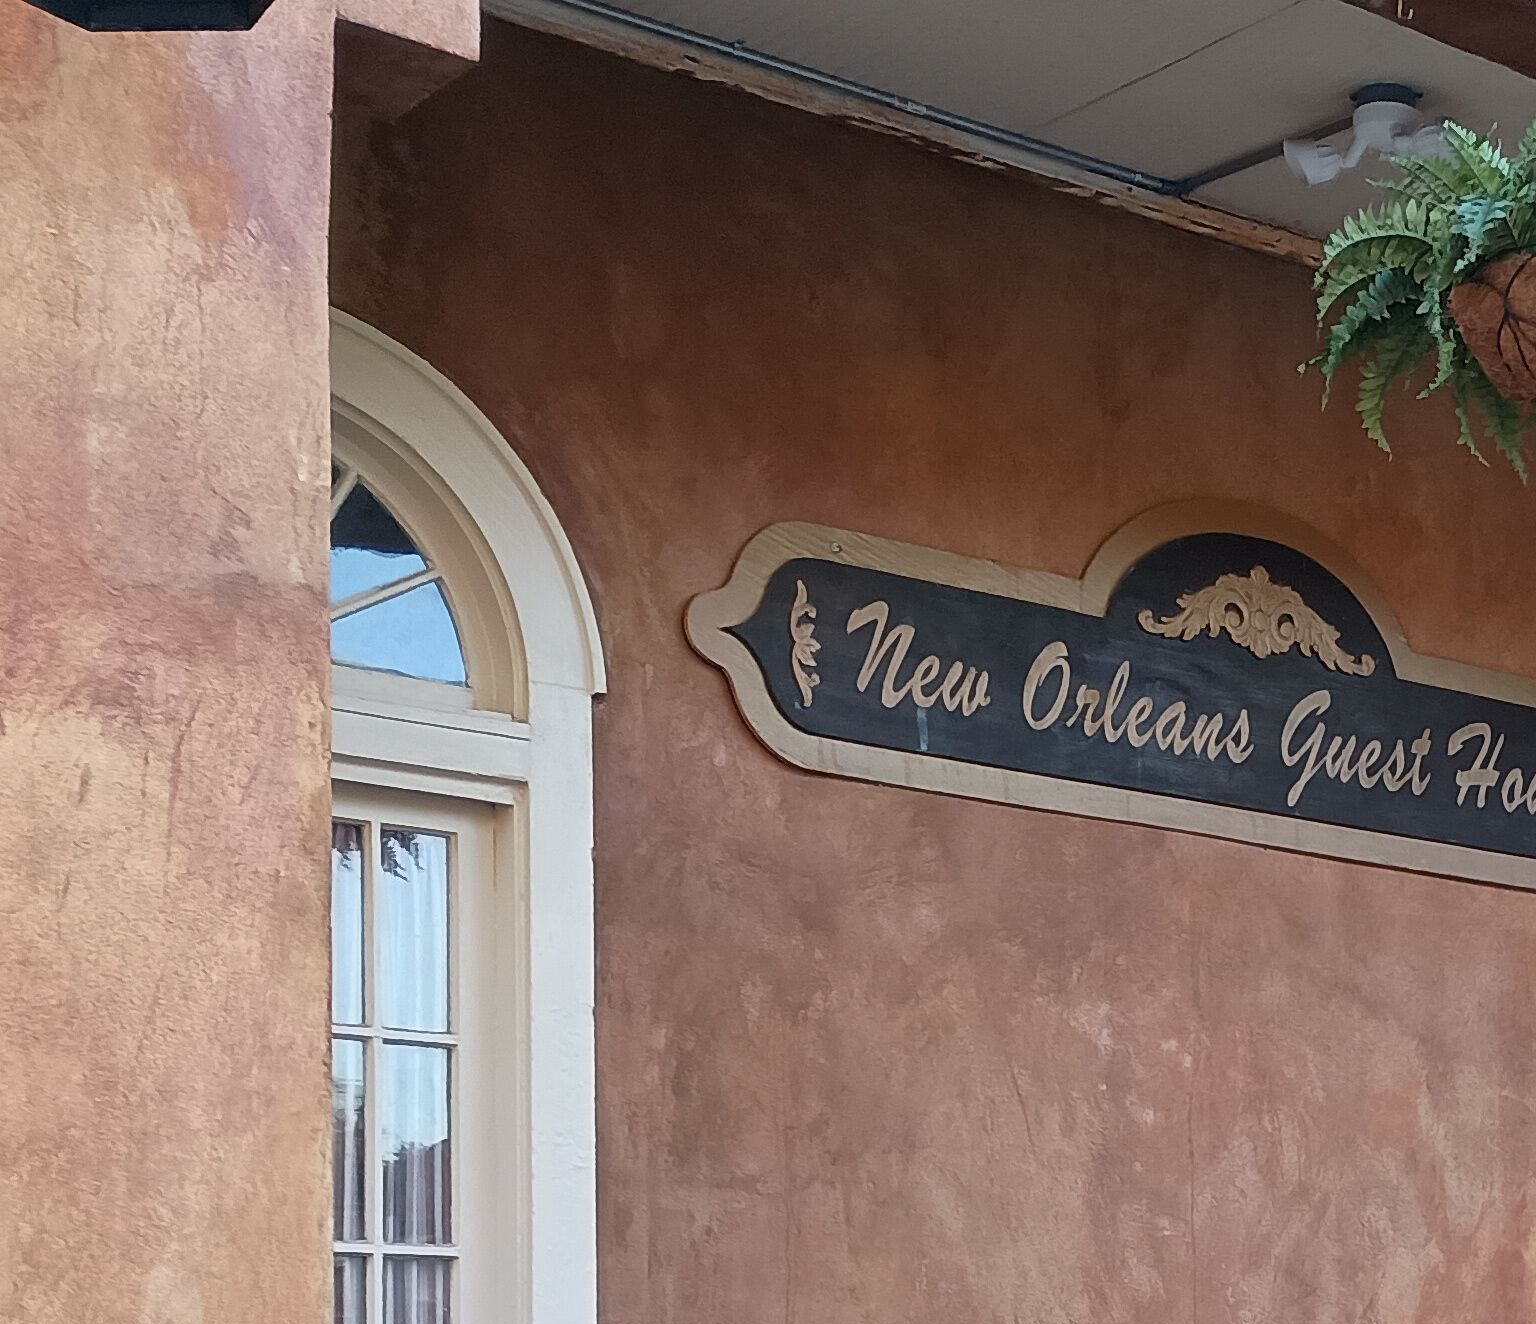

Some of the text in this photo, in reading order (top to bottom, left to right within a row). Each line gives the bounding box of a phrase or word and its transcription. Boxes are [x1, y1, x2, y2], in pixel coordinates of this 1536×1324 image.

[846, 600, 991, 717] New
[1022, 640, 1254, 764] Orleans
[1280, 689, 1431, 807] Guest
